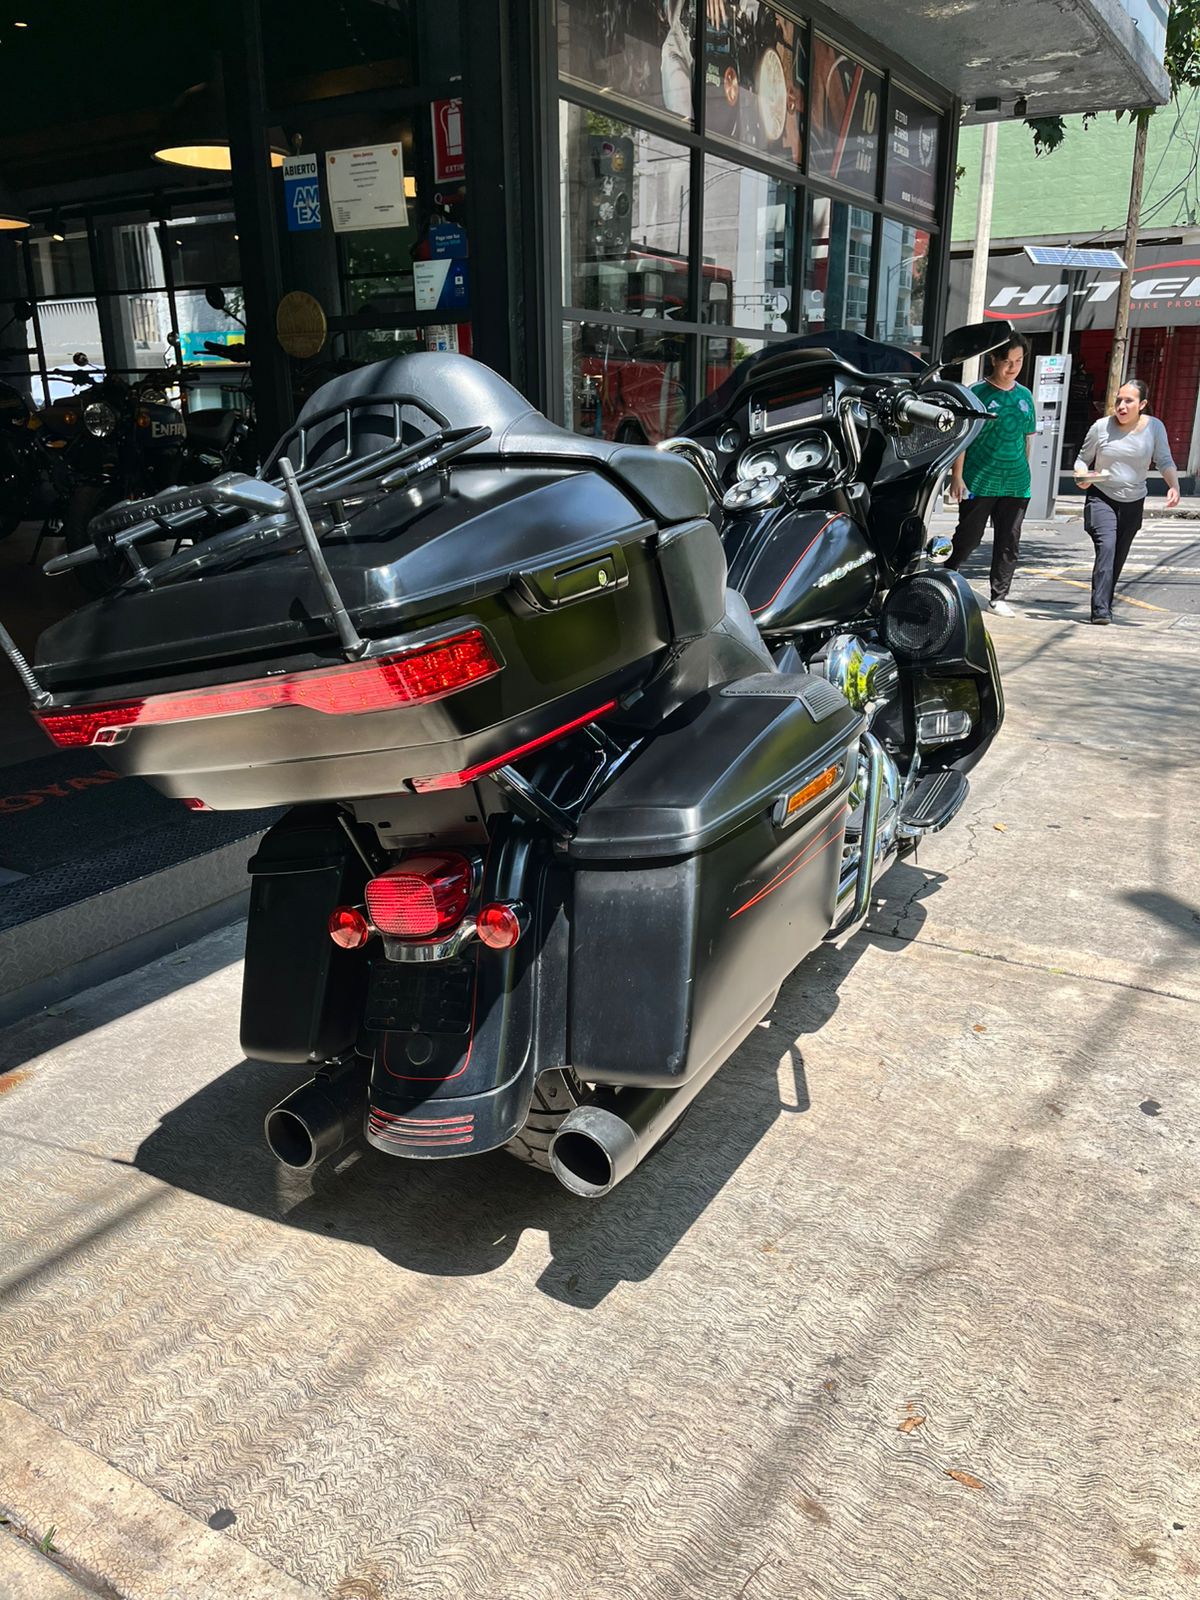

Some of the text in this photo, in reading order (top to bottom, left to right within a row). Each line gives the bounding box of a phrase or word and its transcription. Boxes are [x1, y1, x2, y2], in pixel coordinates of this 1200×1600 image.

[862, 89, 878, 135] 10
[284, 162, 317, 177] ABIERTO
[293, 184, 320, 208] AM
[297, 204, 321, 225] EX
[1129, 301, 1159, 311] BIKE
